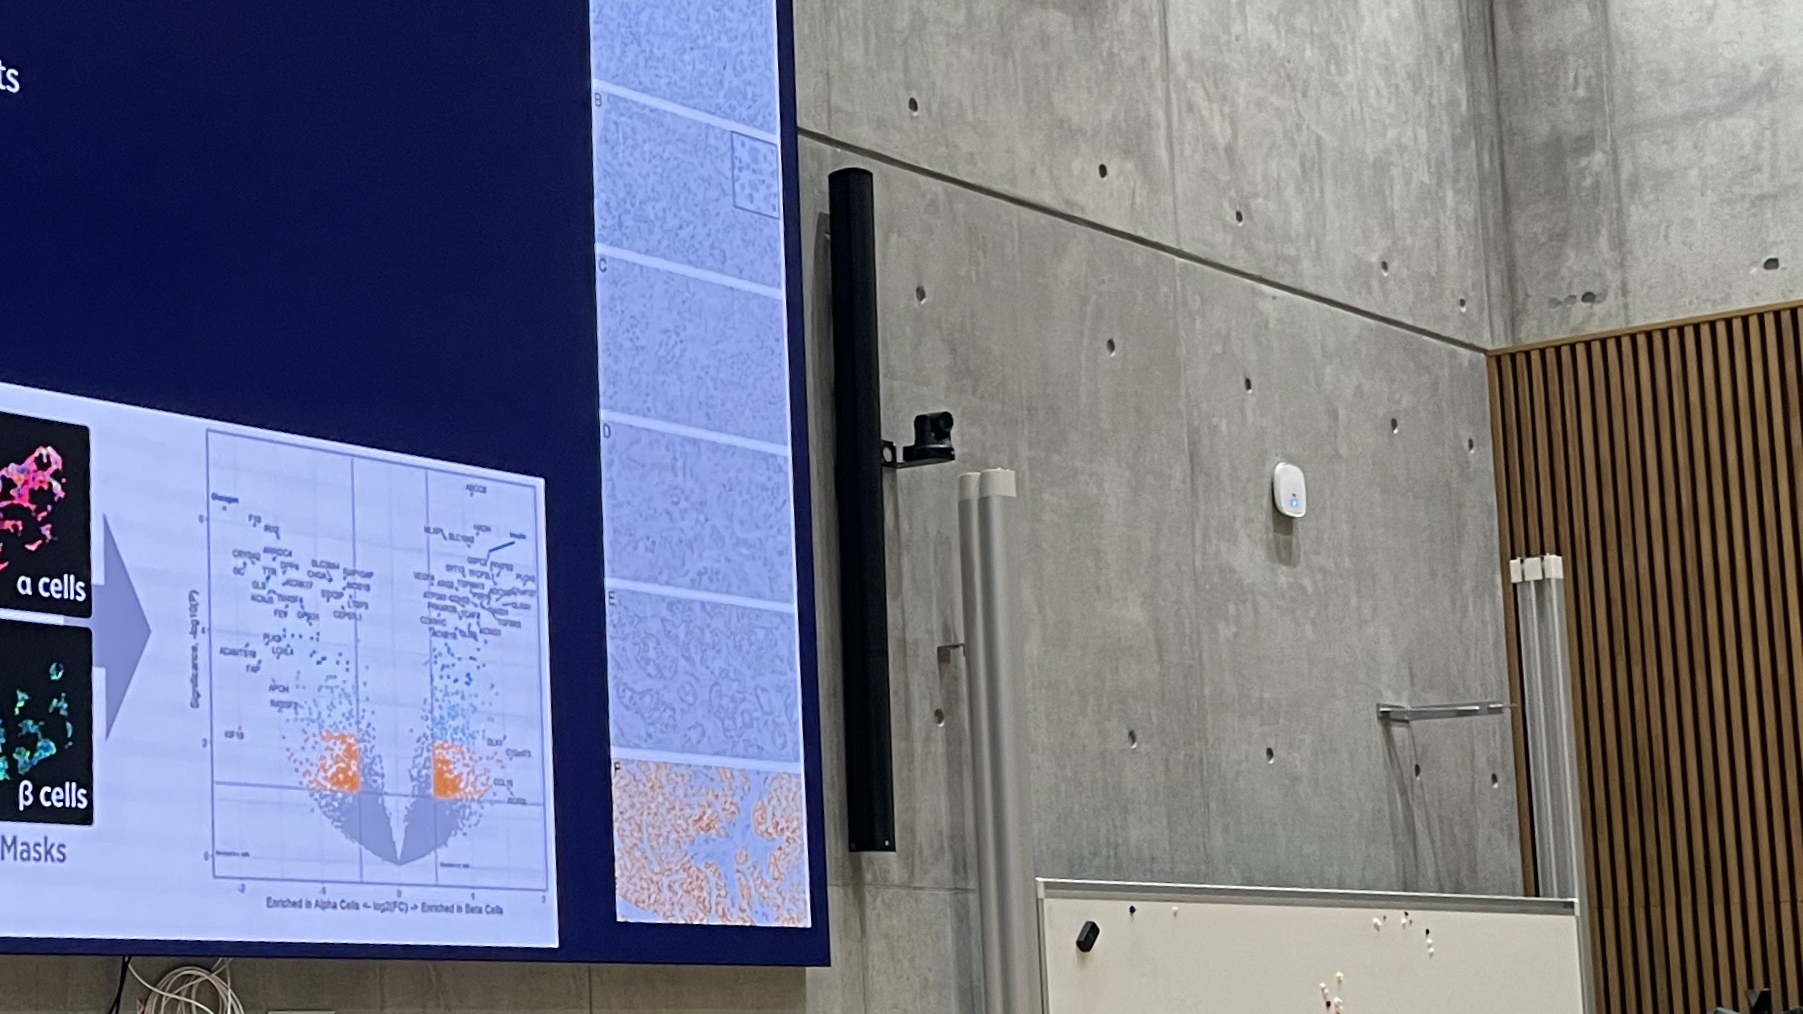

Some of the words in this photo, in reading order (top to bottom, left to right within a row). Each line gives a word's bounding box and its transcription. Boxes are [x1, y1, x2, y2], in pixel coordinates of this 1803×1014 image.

[38, 573, 87, 602] cells
[39, 781, 88, 809] cells
[0, 833, 68, 864] Masks
